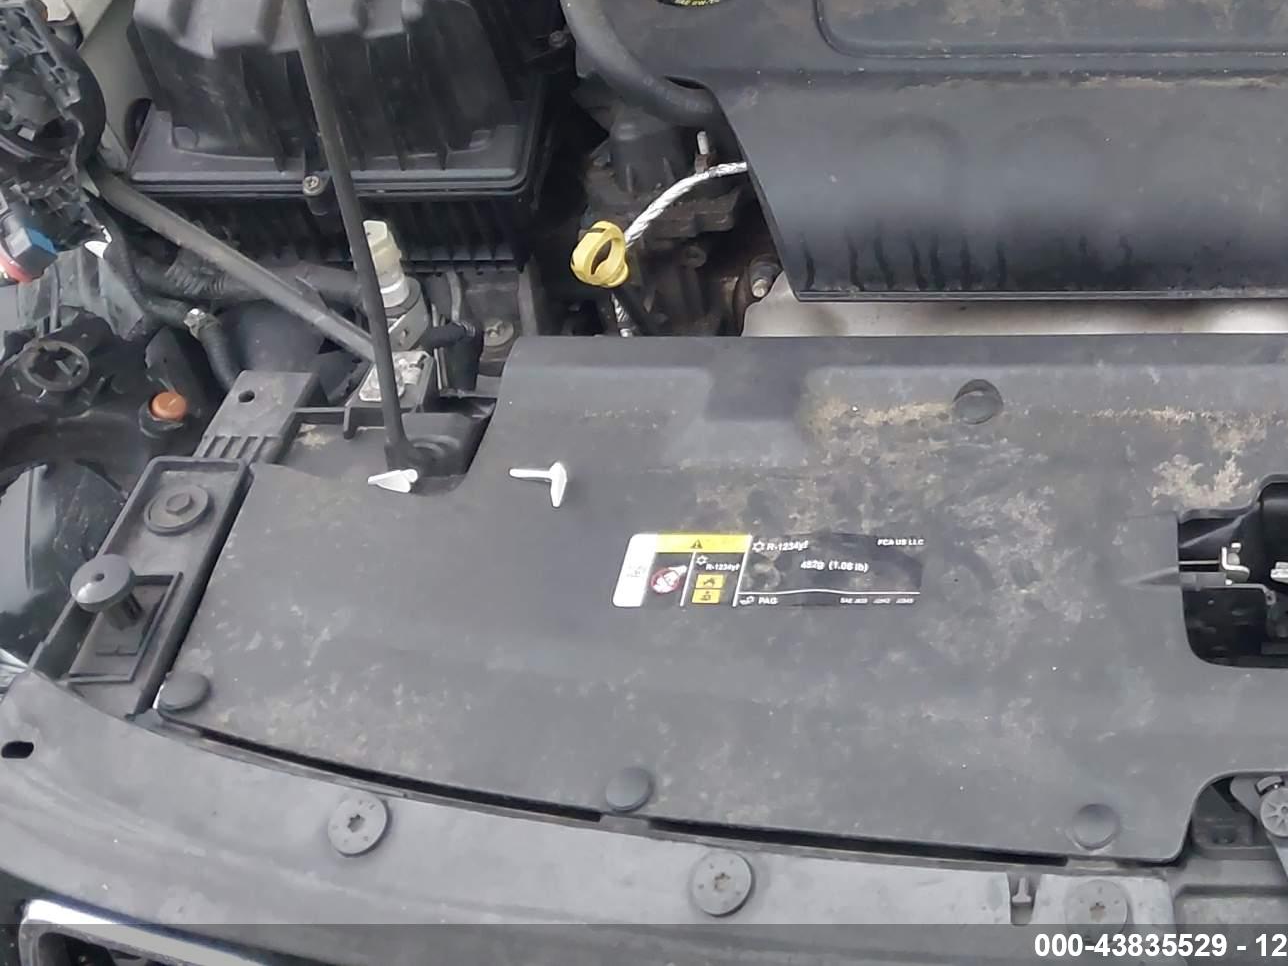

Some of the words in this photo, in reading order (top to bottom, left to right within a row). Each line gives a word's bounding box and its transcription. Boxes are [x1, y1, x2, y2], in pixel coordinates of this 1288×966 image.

[766, 539, 809, 551] R-1234yf
[877, 538, 895, 546] FCA
[895, 538, 907, 546] US
[908, 538, 924, 546] LLC
[758, 596, 778, 605] PAG
